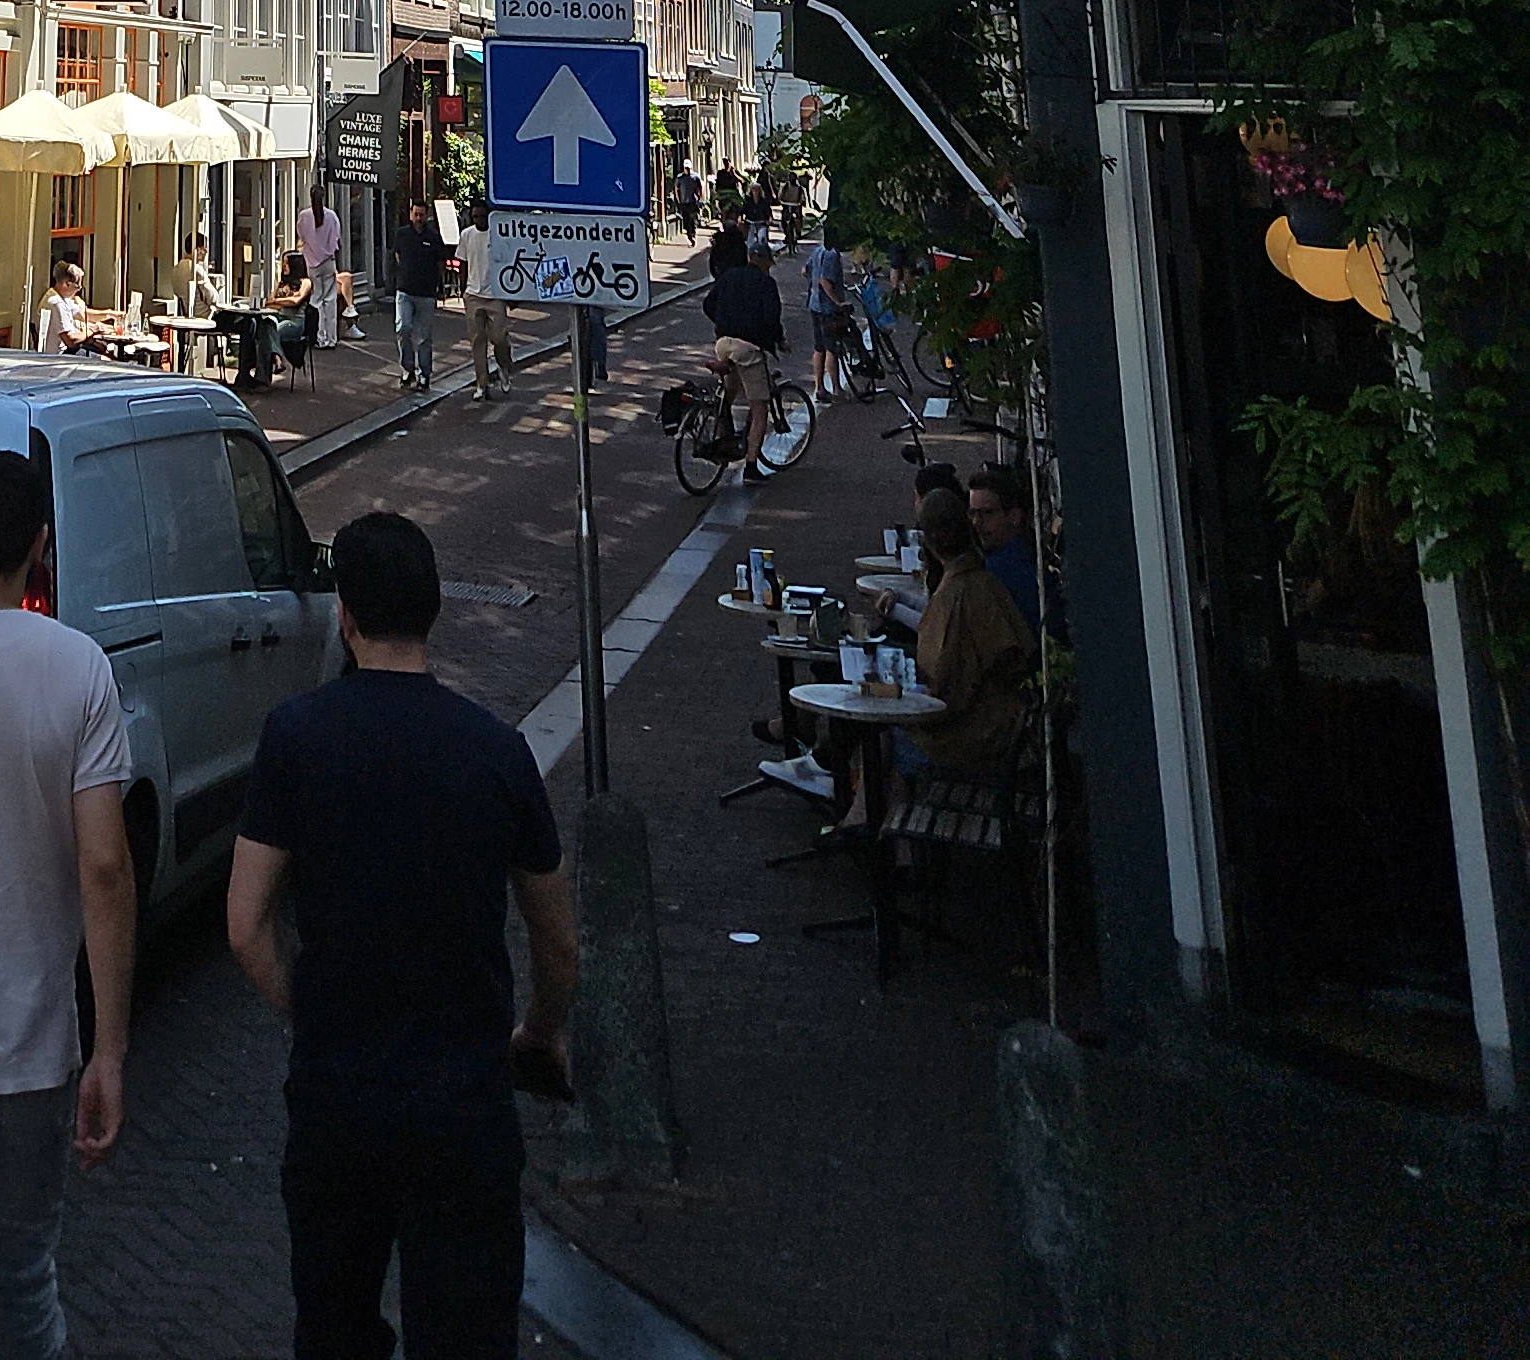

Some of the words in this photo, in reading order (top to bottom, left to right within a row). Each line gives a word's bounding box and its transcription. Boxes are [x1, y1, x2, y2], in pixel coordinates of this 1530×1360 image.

[501, 0, 627, 21] 12.00-18.00h
[356, 112, 383, 124] LUXE
[340, 120, 382, 134] VINTAGE
[339, 133, 382, 149] CHANEL
[337, 145, 381, 161] HERMÈS
[342, 158, 372, 171] LOUIS
[334, 168, 378, 184] VUITTON
[498, 219, 636, 244] uitgezonderd
